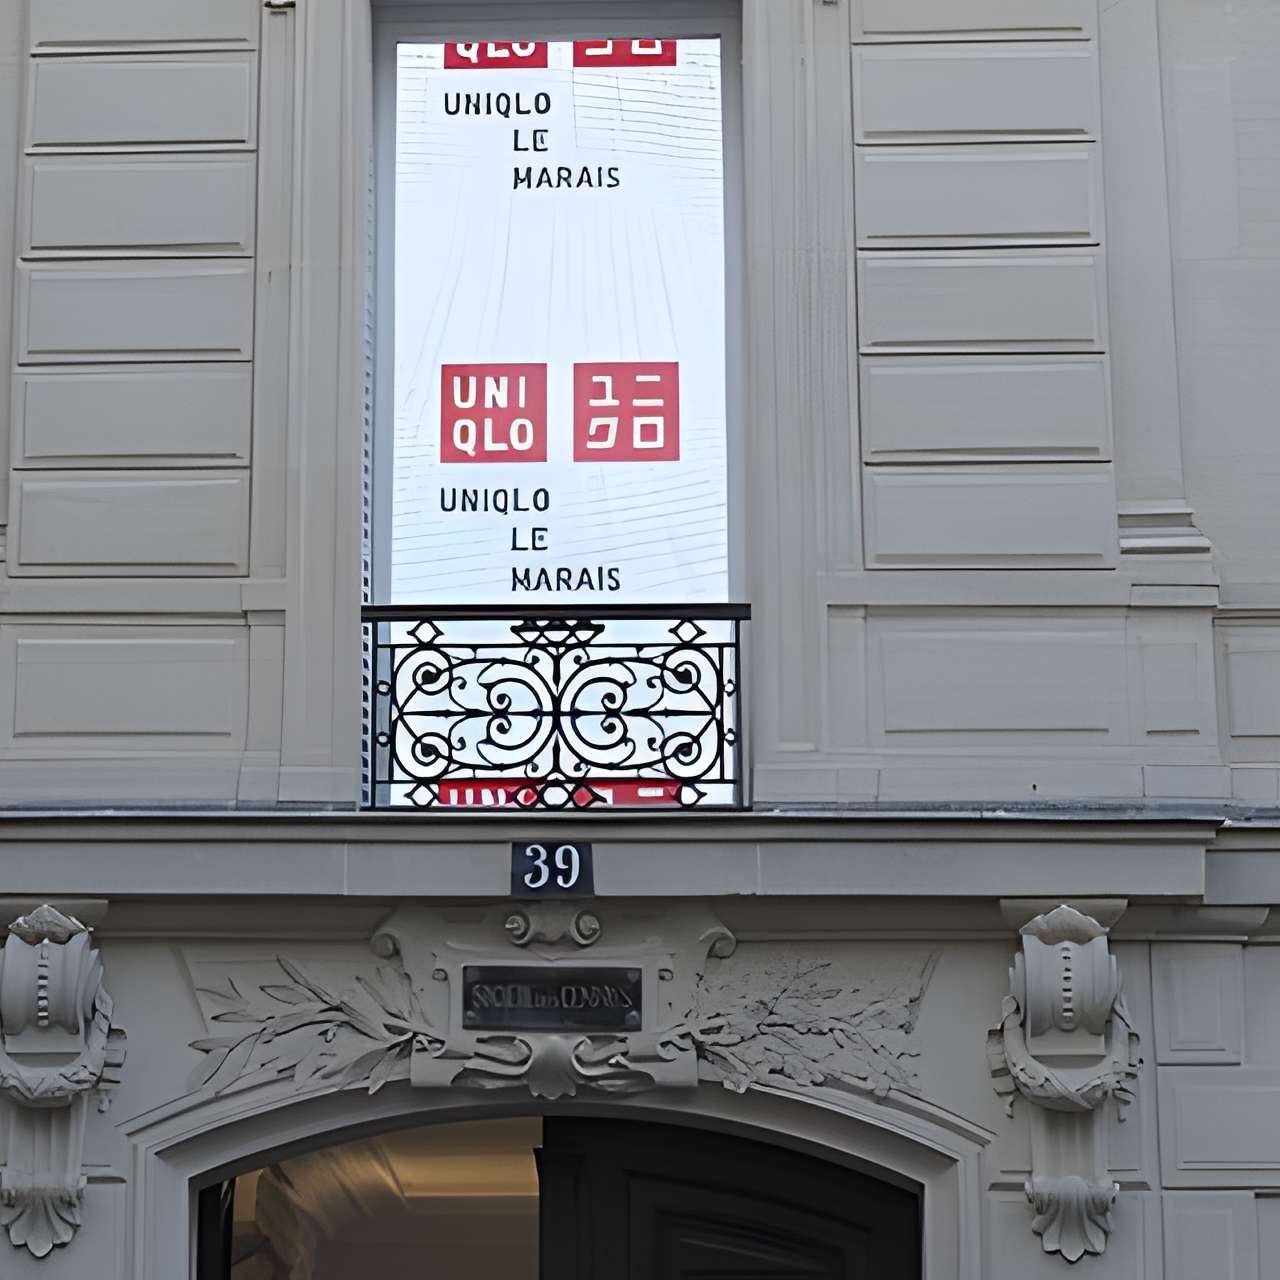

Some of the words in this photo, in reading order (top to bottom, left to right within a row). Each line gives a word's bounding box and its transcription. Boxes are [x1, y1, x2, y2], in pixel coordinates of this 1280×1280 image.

[443, 92, 551, 119] UNIQLO
[513, 129, 549, 152] LE
[513, 166, 621, 190] MARAIS
[453, 375, 526, 409] UNI
[453, 418, 534, 457] QLO
[440, 487, 550, 516] UNIQLO
[510, 527, 548, 551] LE
[511, 566, 621, 592] MARAIS
[524, 844, 580, 888] 39
